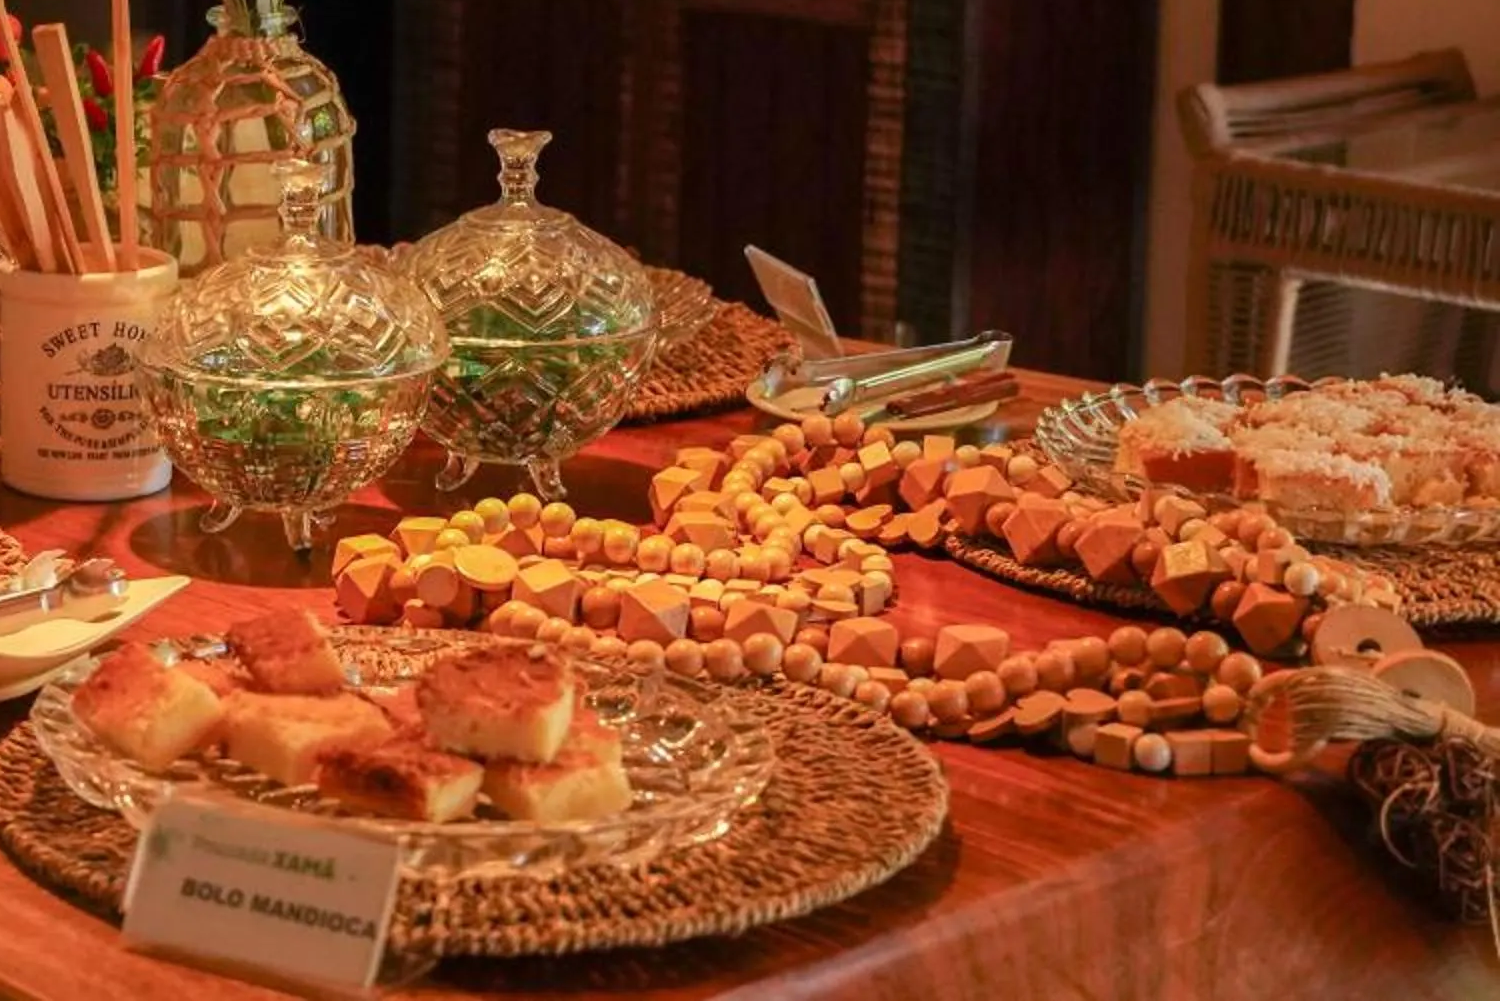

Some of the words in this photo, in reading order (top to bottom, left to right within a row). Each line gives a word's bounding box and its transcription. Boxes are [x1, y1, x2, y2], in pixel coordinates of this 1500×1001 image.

[40, 321, 100, 359] SWEET
[180, 876, 245, 909] BOLO
[250, 893, 377, 941] MANDIOCA
